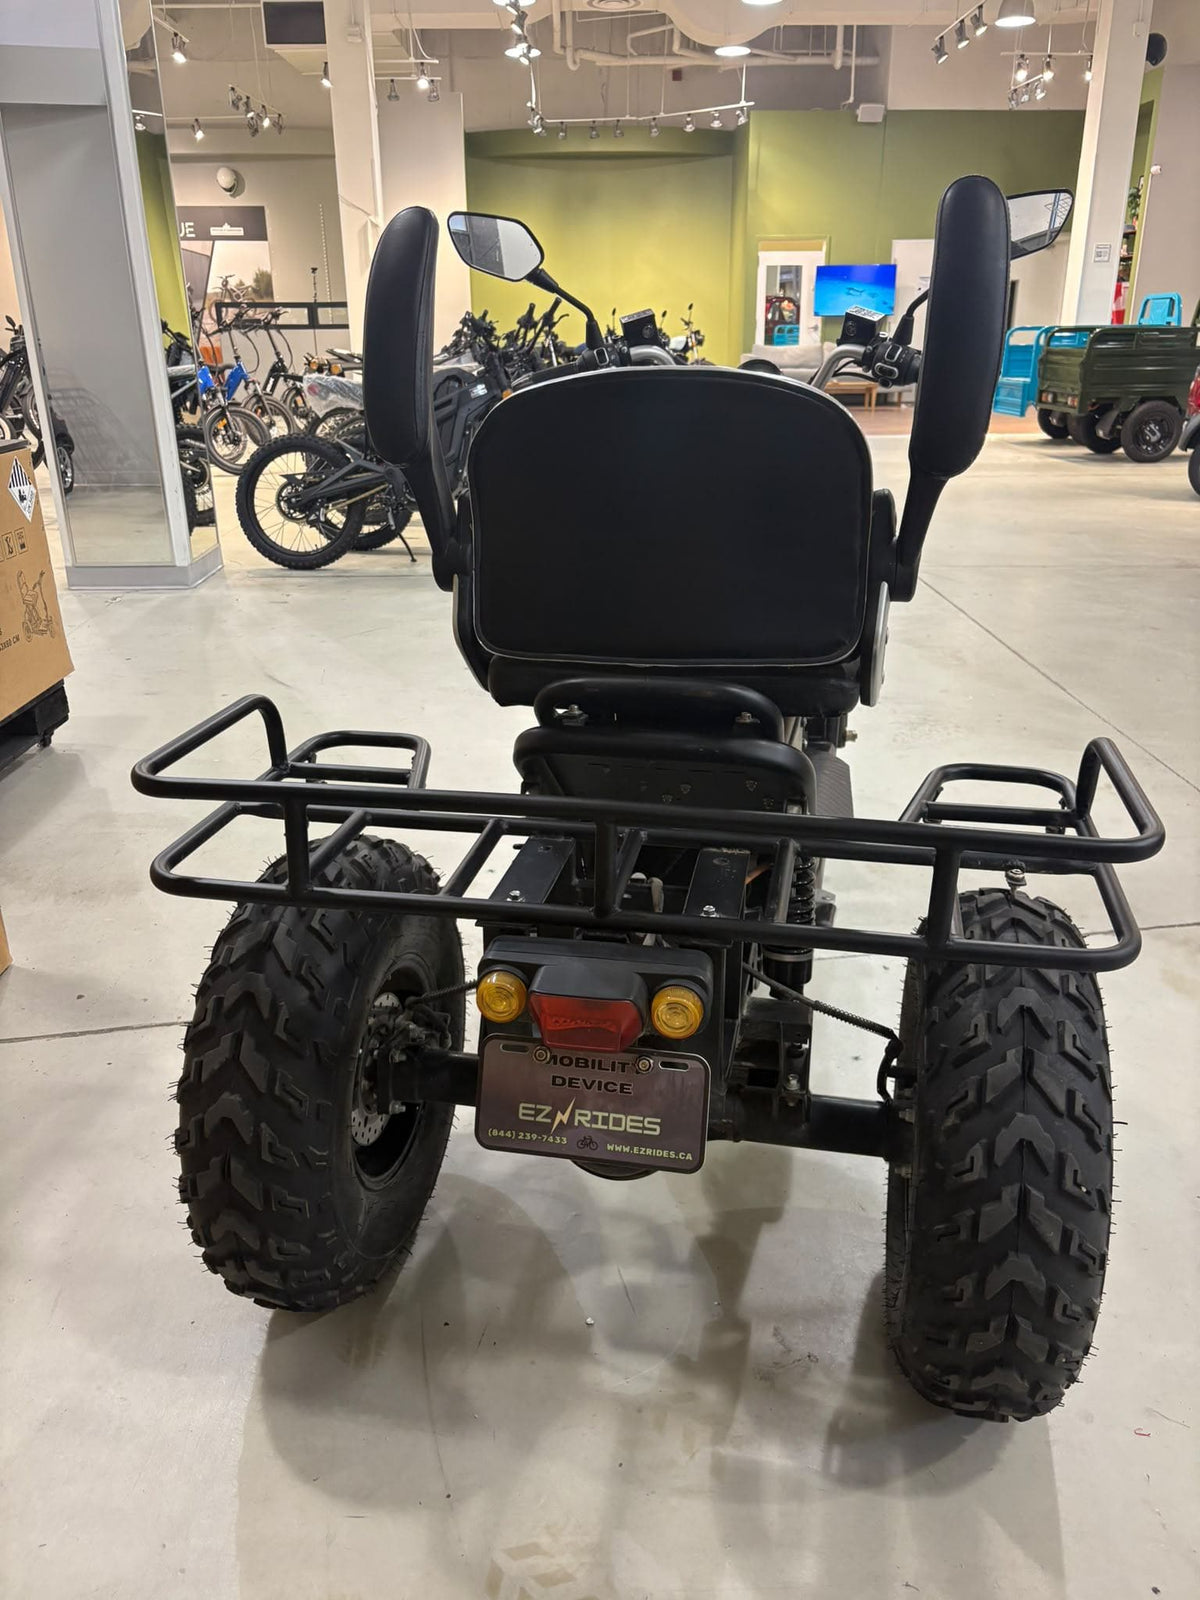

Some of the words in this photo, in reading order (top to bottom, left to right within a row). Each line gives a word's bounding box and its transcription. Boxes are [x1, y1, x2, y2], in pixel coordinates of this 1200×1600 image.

[551, 1074, 633, 1095] DEVICE
[518, 1102, 553, 1123] EZ
[574, 1109, 662, 1136] RIDES
[487, 1127, 516, 1140] (844)
[517, 1131, 568, 1145] 239-7433
[606, 1142, 693, 1161] WWW.EZRIDES.CA
